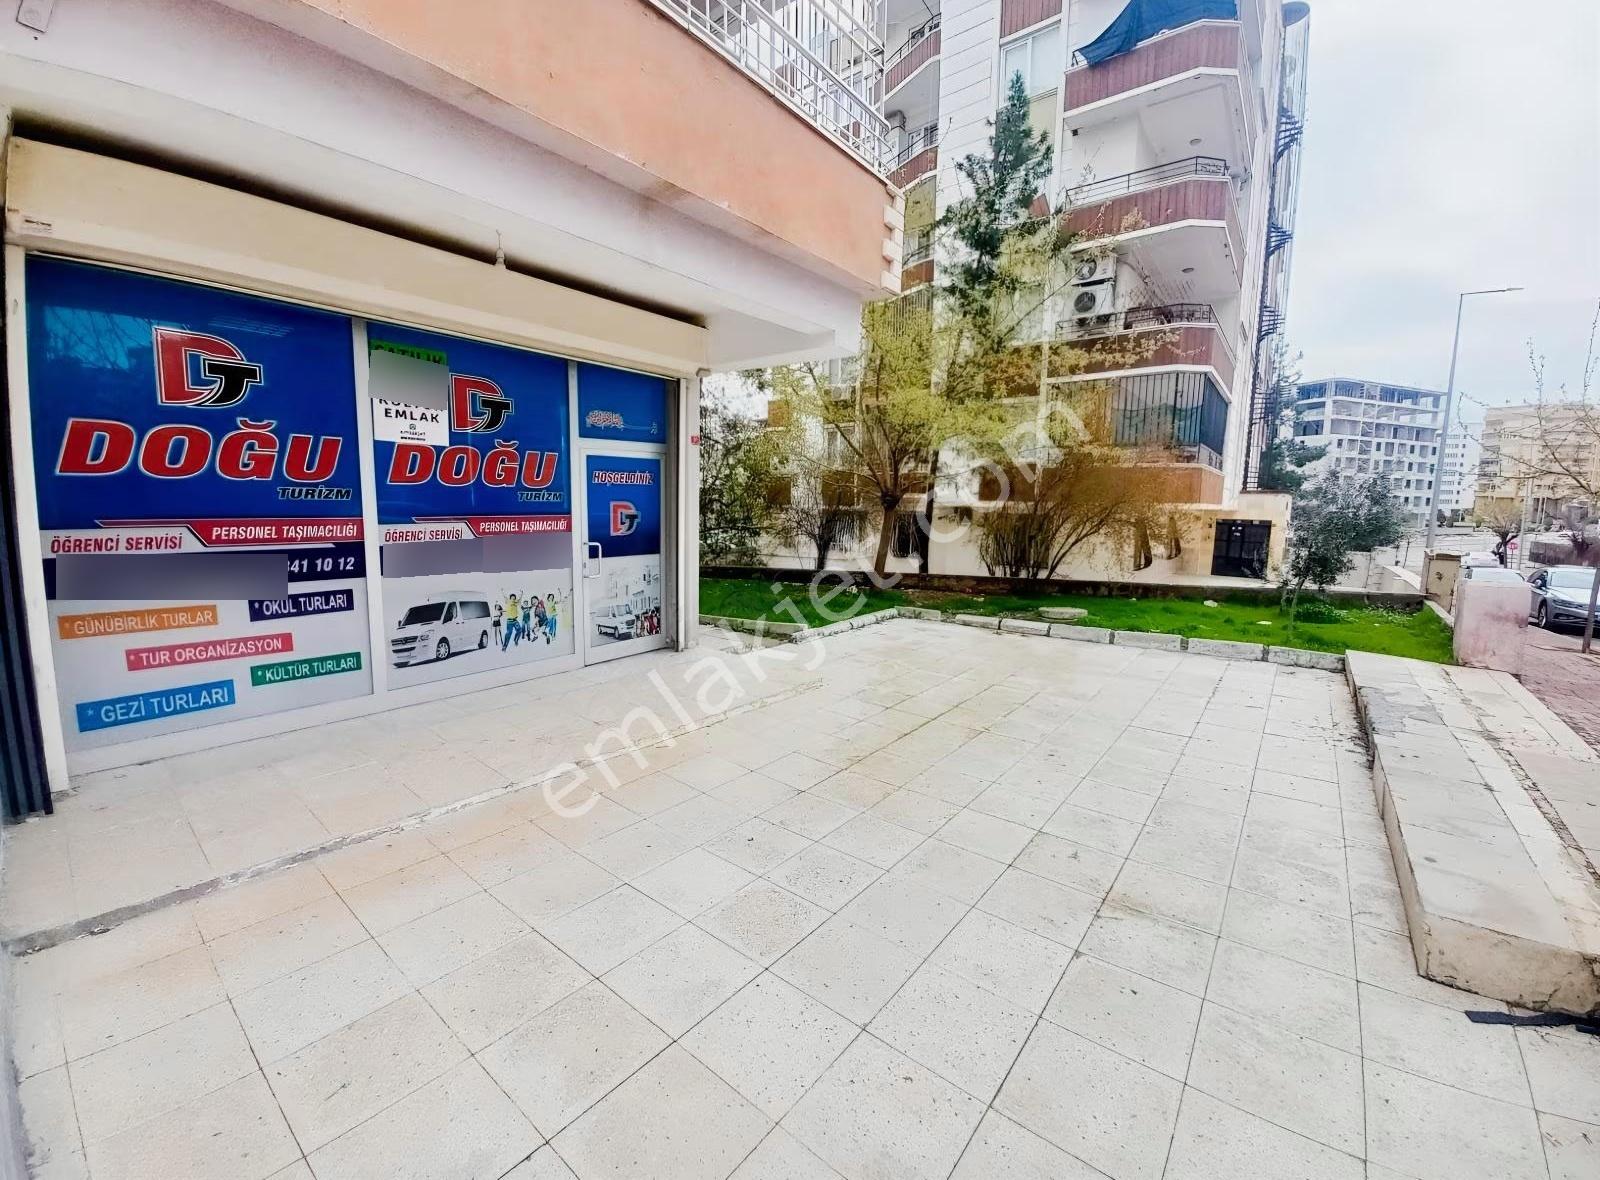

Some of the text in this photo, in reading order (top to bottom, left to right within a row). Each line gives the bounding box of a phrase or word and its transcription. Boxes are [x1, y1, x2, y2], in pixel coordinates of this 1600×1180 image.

[384, 407, 440, 424] EMLAK
[55, 417, 343, 483] DOĞU
[387, 439, 559, 488] DOĞU
[592, 470, 655, 487] HOŞGELDİNİZ
[277, 484, 353, 501] TURİZM
[518, 490, 564, 502] TURİZM
[211, 522, 358, 542] PERSONEL TAŞIMACILIĞI
[384, 526, 464, 543] ÖĞRENCİ SERVİSİ
[479, 518, 568, 534] PERSONEL TAŞIMACILIĞI
[51, 532, 183, 554] ÖĞRENCİ SERVİSİ
[287, 556, 356, 573] 41 10 12
[262, 593, 348, 616] OKUL TURLARI
[73, 609, 214, 635] GÜNÜBİRLİK TURLAR
[139, 637, 283, 667] TUR ORGANİZASYON
[265, 656, 357, 682] KÜLTÜR TURLARI
[100, 685, 229, 723] GEZİ TURLARI
